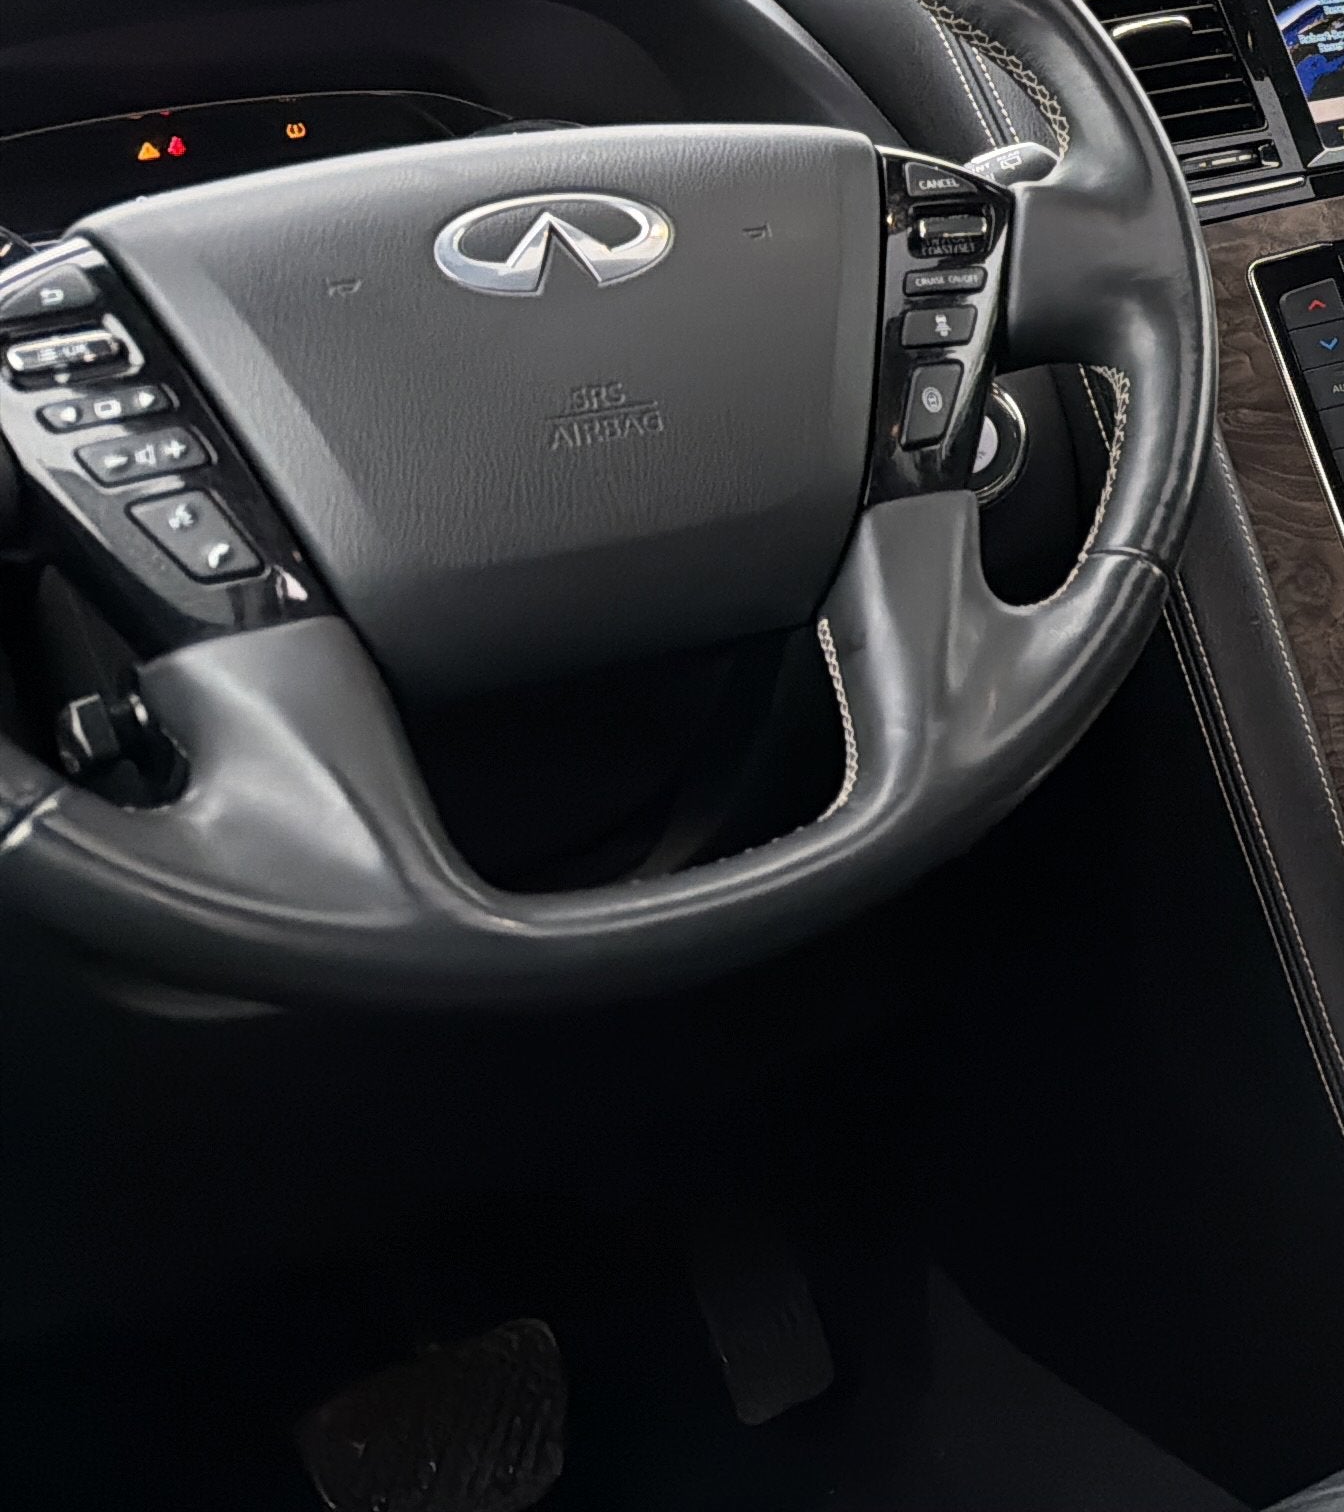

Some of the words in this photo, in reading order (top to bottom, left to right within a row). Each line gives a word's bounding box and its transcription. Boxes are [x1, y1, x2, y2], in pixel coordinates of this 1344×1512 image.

[918, 177, 960, 191] CANCEL
[914, 276, 945, 287] CRUISE
[571, 381, 627, 412] SRS
[550, 410, 664, 451] AIRBAG
